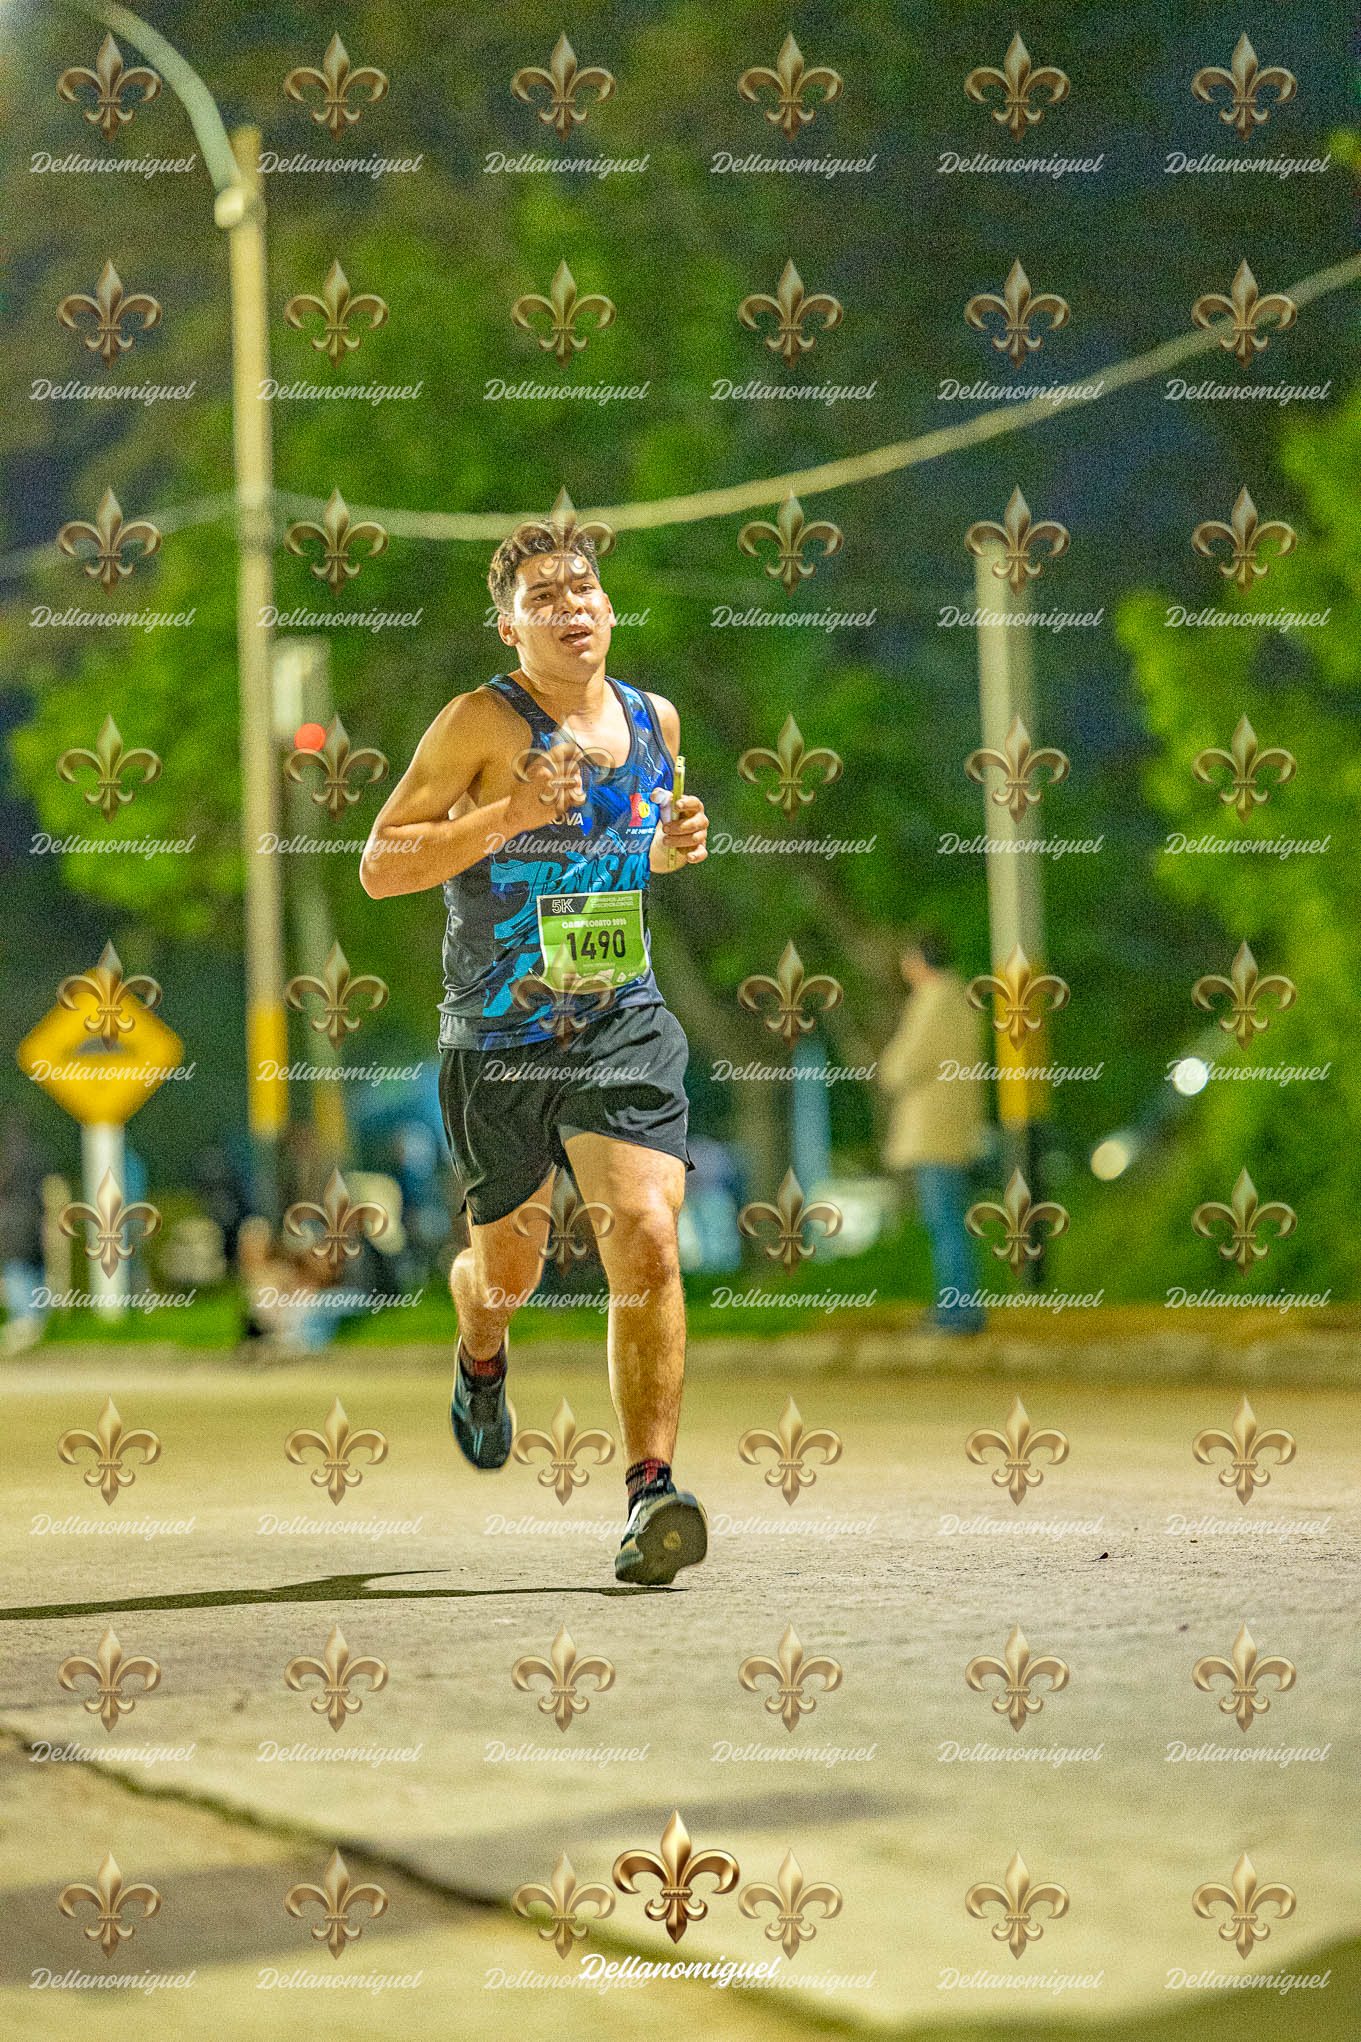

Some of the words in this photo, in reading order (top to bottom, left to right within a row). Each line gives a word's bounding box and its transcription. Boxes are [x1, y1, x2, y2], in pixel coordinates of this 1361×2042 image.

[549, 812, 584, 826] OVA
[552, 898, 575, 913] 5K
[566, 929, 626, 961] 1490
